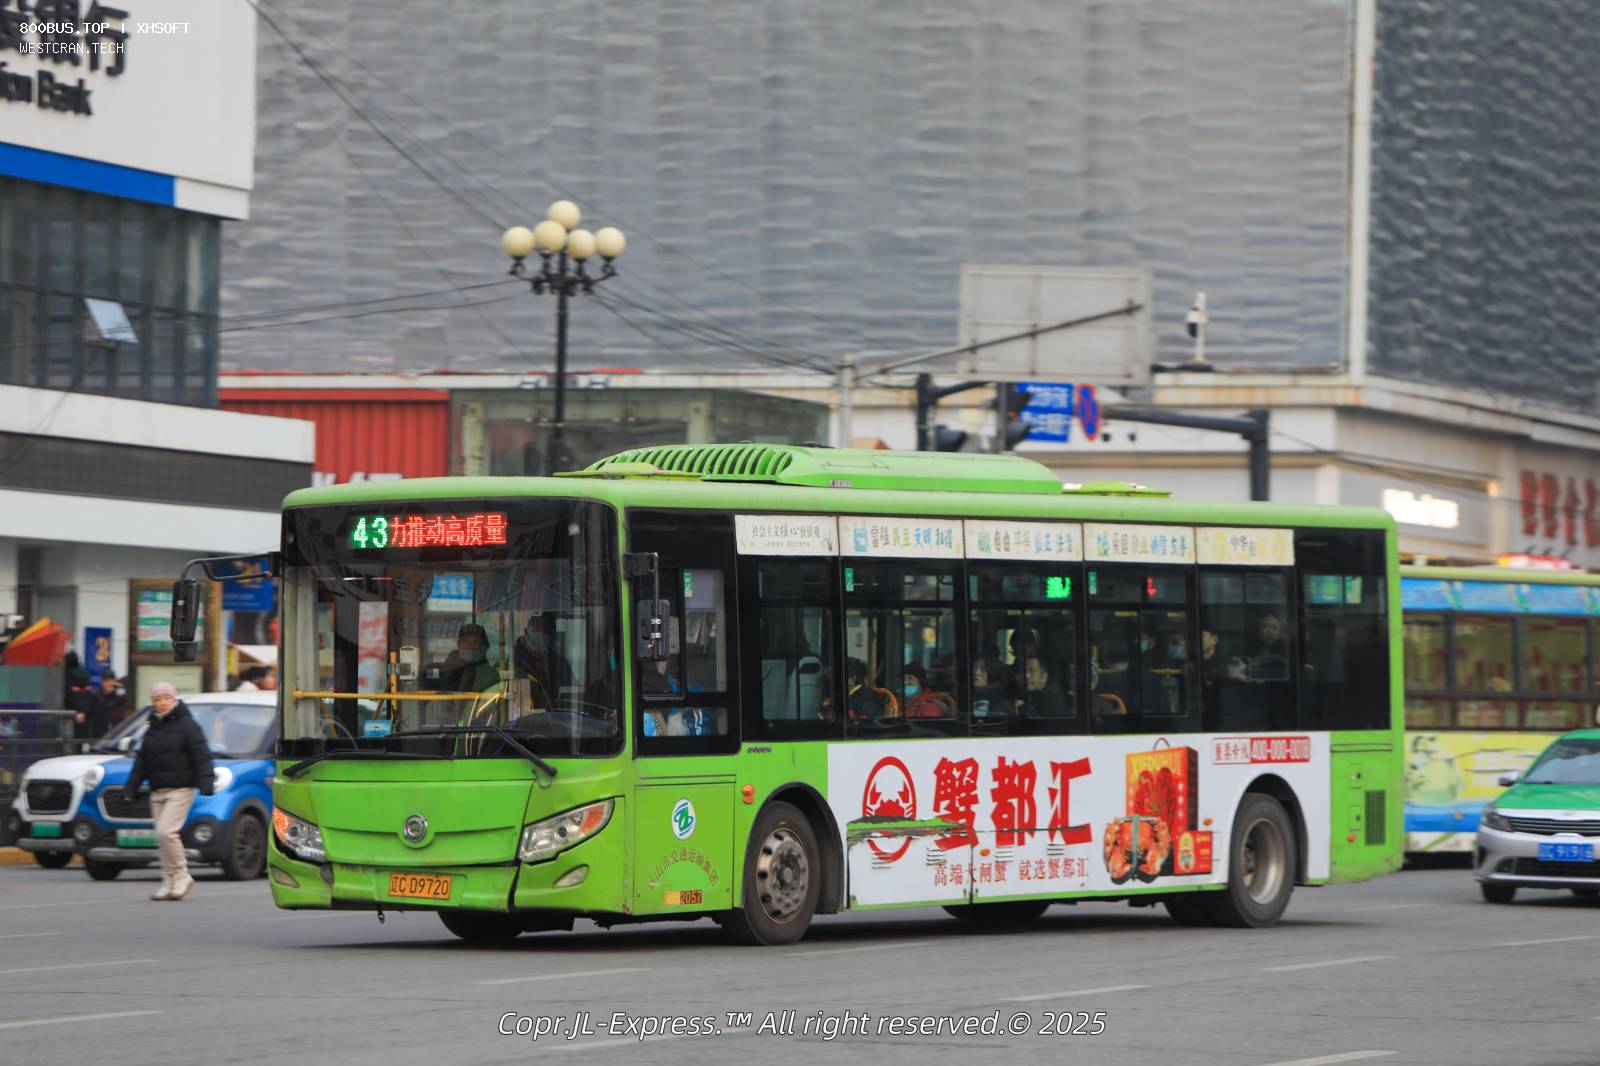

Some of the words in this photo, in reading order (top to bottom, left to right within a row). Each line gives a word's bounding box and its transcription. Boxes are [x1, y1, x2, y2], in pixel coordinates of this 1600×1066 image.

[38, 69, 93, 116] Bank
[353, 517, 388, 548] 43
[391, 513, 507, 547] 力推动高质量
[932, 755, 1093, 852] 蟹都汇
[680, 891, 702, 904] 2057
